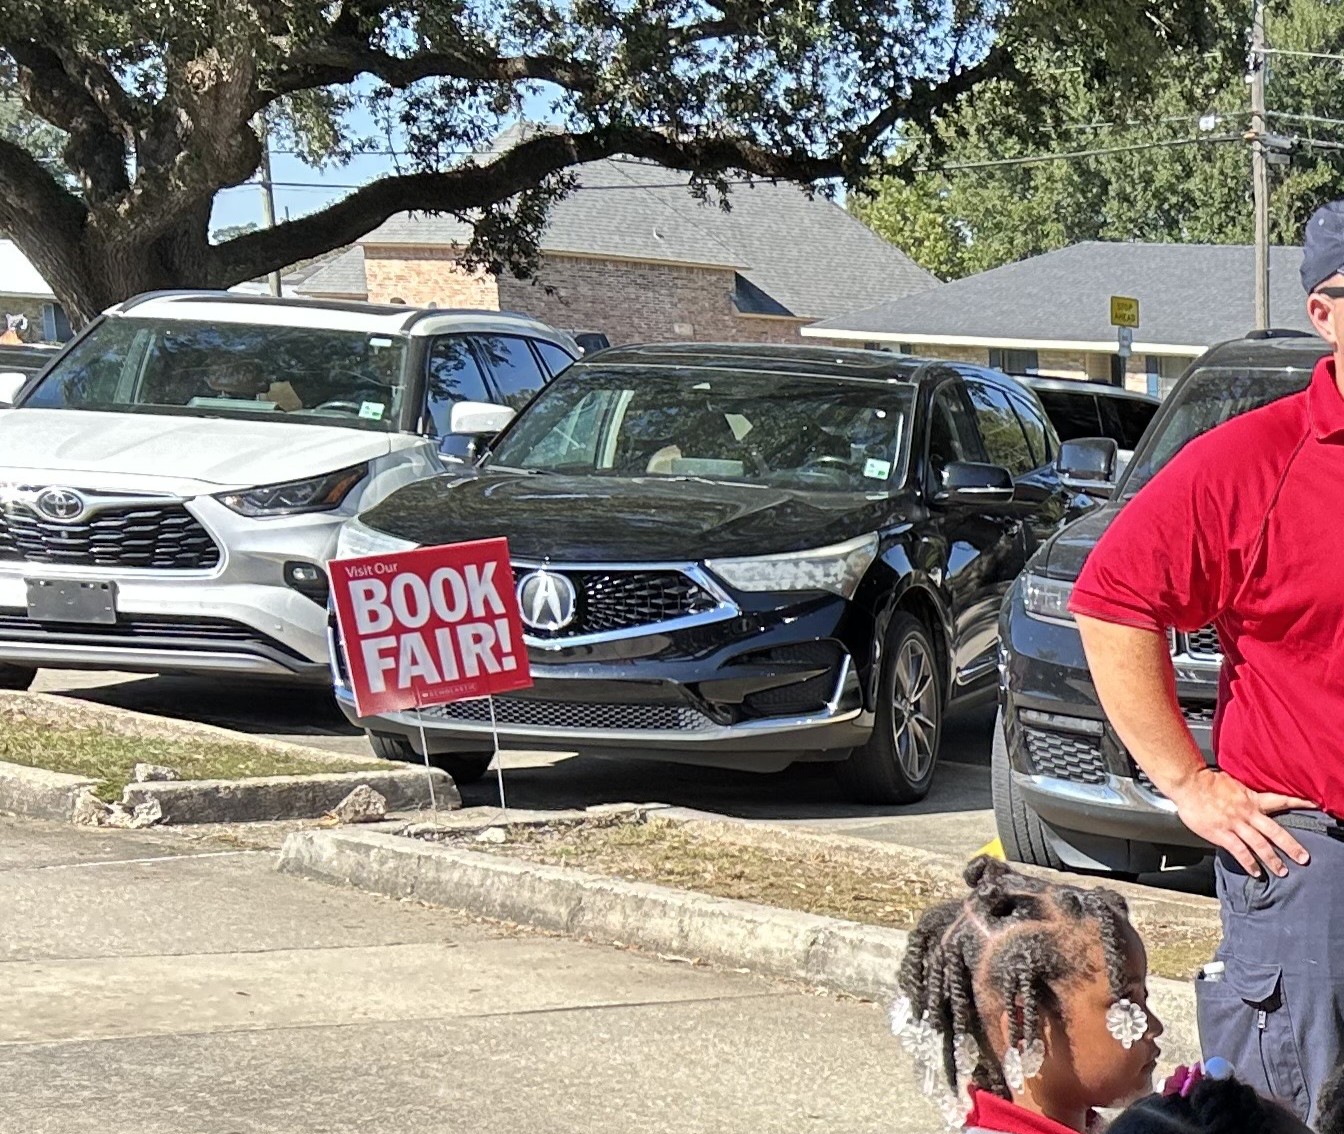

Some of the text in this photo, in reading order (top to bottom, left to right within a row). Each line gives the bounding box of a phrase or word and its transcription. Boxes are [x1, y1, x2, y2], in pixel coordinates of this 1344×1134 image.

[345, 562, 398, 578] Visit Our
[348, 561, 507, 635] BOOK
[360, 618, 517, 694] FAIR!
